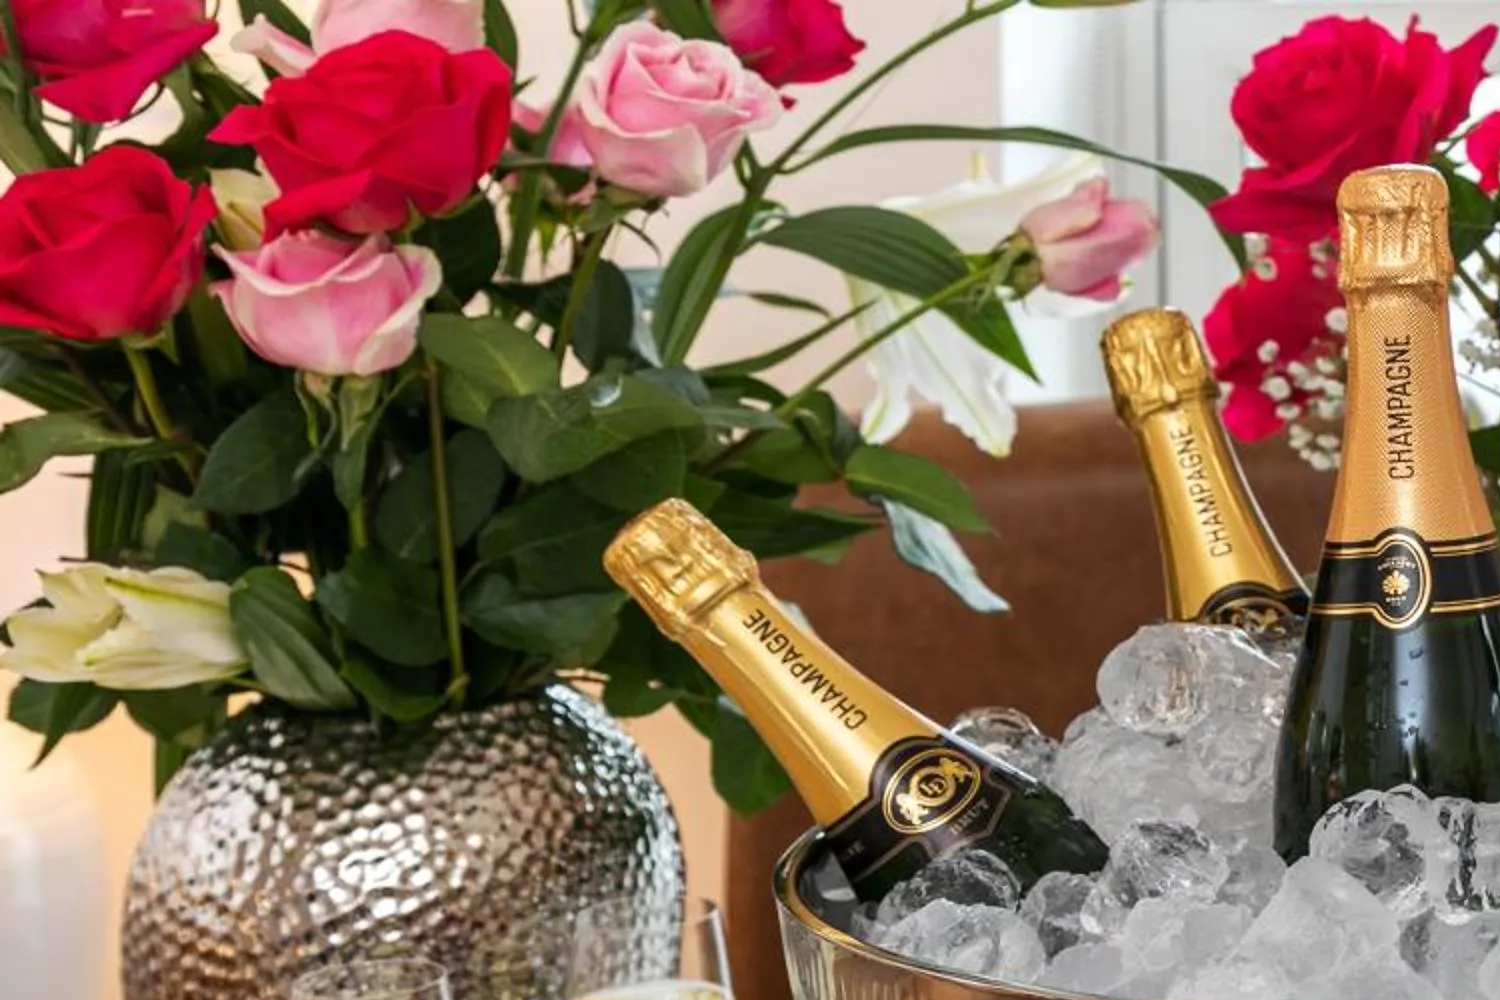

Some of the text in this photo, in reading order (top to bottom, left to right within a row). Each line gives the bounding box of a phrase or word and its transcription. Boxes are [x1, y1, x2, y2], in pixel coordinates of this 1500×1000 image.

[1384, 333, 1415, 480] CHAMPAGNE
[1169, 425, 1233, 557] CHAMPAGNE
[742, 608, 868, 730] CHAMPAGNE
